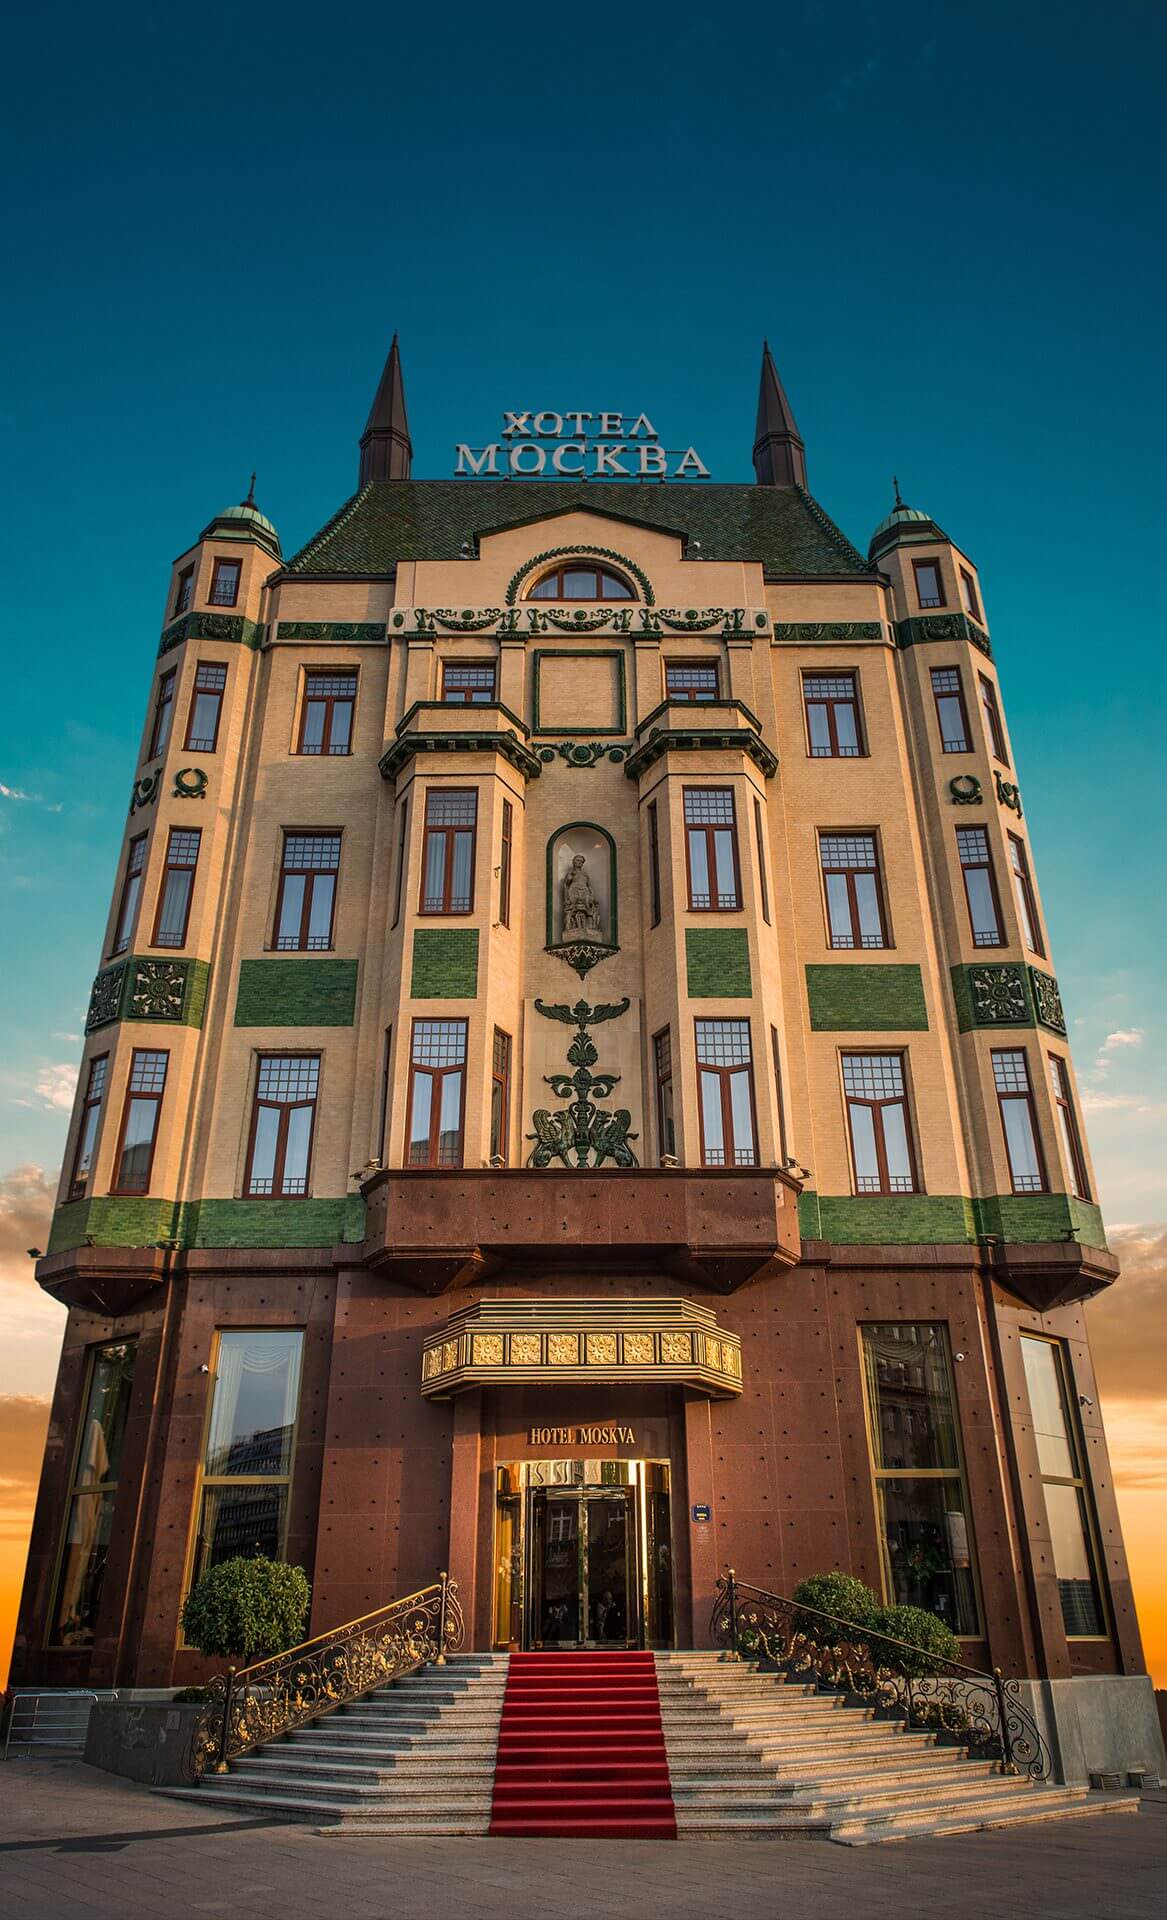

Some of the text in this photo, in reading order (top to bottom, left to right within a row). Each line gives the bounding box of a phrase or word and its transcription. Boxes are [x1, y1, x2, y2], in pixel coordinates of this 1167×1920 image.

[502, 411, 659, 437] ХОТЕЛ
[454, 443, 711, 477] МОСКВА
[530, 1426, 636, 1445] HOTEL MOSKVA
